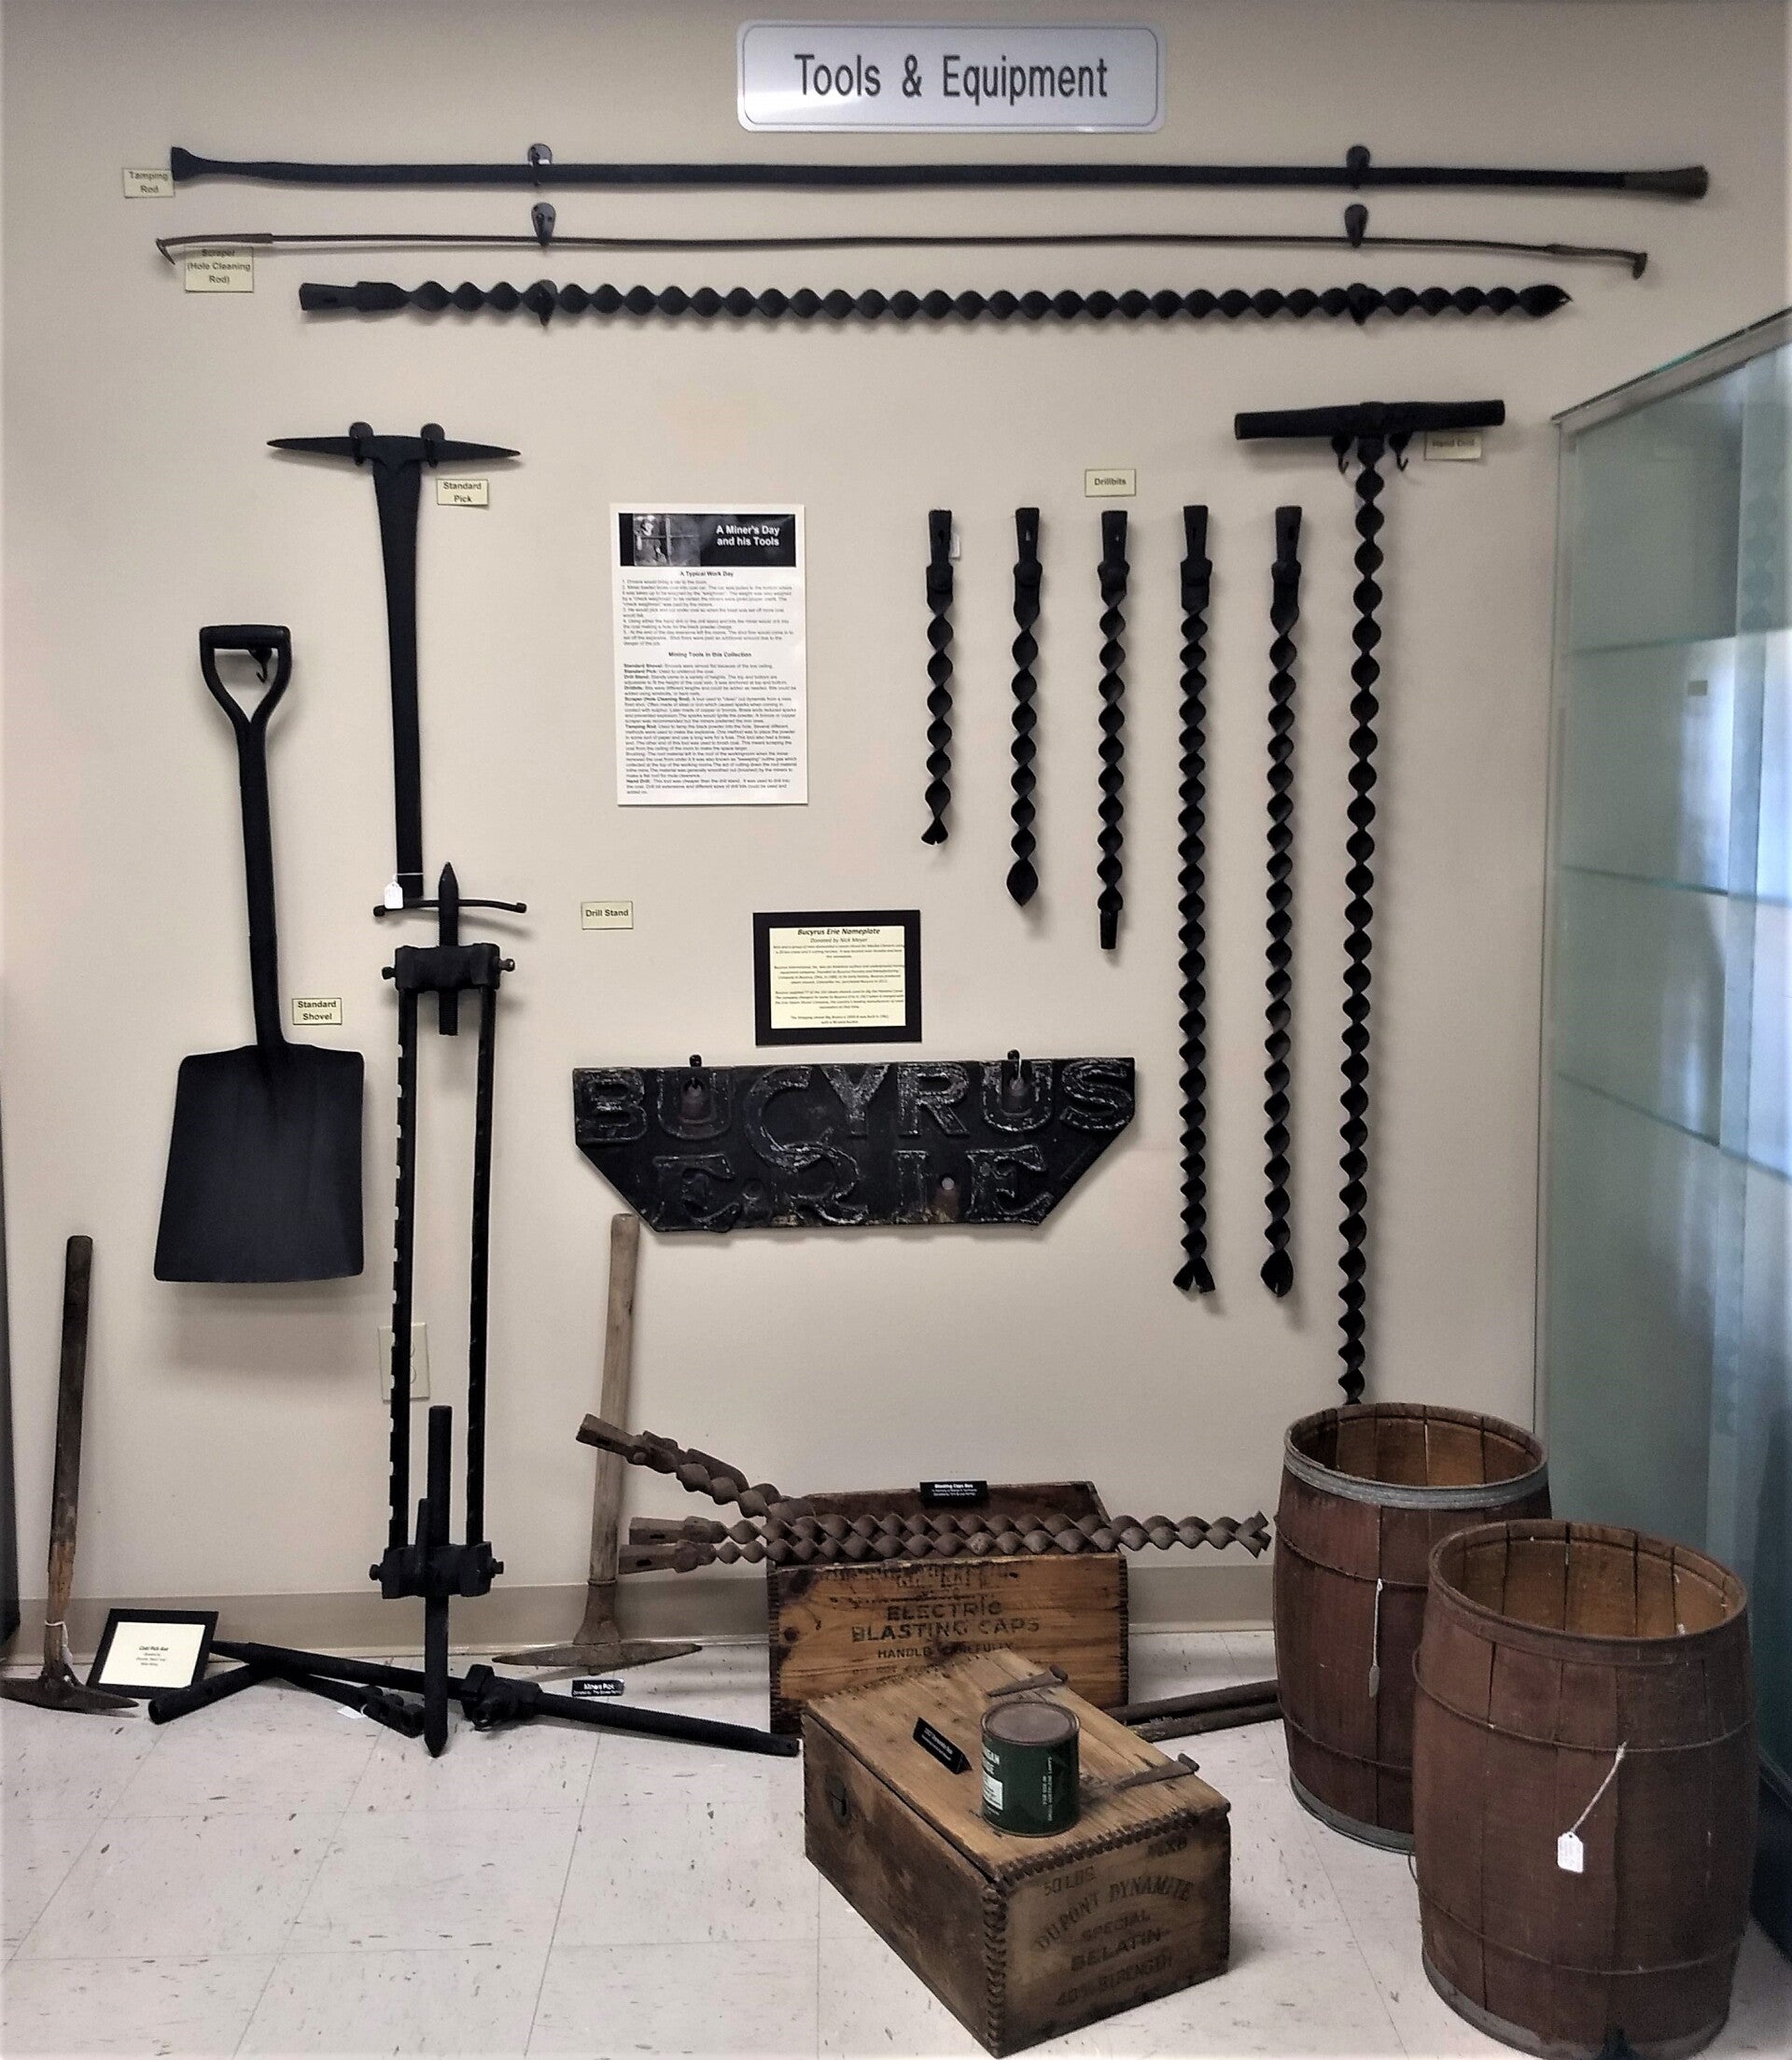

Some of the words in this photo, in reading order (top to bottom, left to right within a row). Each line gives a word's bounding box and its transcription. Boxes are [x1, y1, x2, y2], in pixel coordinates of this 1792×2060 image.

[793, 54, 880, 98] Tools
[902, 54, 922, 98] &
[942, 54, 1109, 106] Equipment
[129, 171, 169, 182] Tamping
[140, 185, 160, 194] Rod
[187, 262, 210, 272] (Hole
[212, 262, 251, 273] Cleaning
[208, 274, 231, 285] Rod)
[443, 481, 483, 490] Standard
[1094, 478, 1127, 486] Drillbits
[454, 495, 472, 503] Pick
[716, 526, 724, 535] A
[725, 525, 760, 535] Miner's
[762, 526, 780, 537] Day
[717, 537, 735, 546] and
[736, 537, 751, 546] his
[753, 537, 780, 546] Tools
[573, 1058, 1137, 1170] BUCYRUS
[887, 1600, 1003, 1621] ELECTRIC
[851, 1621, 970, 1643] BLASTING
[979, 1617, 1040, 1634] CAPS
[876, 1647, 932, 1660] HANDLE
[1109, 1874, 1194, 1902] DYNAMITE
